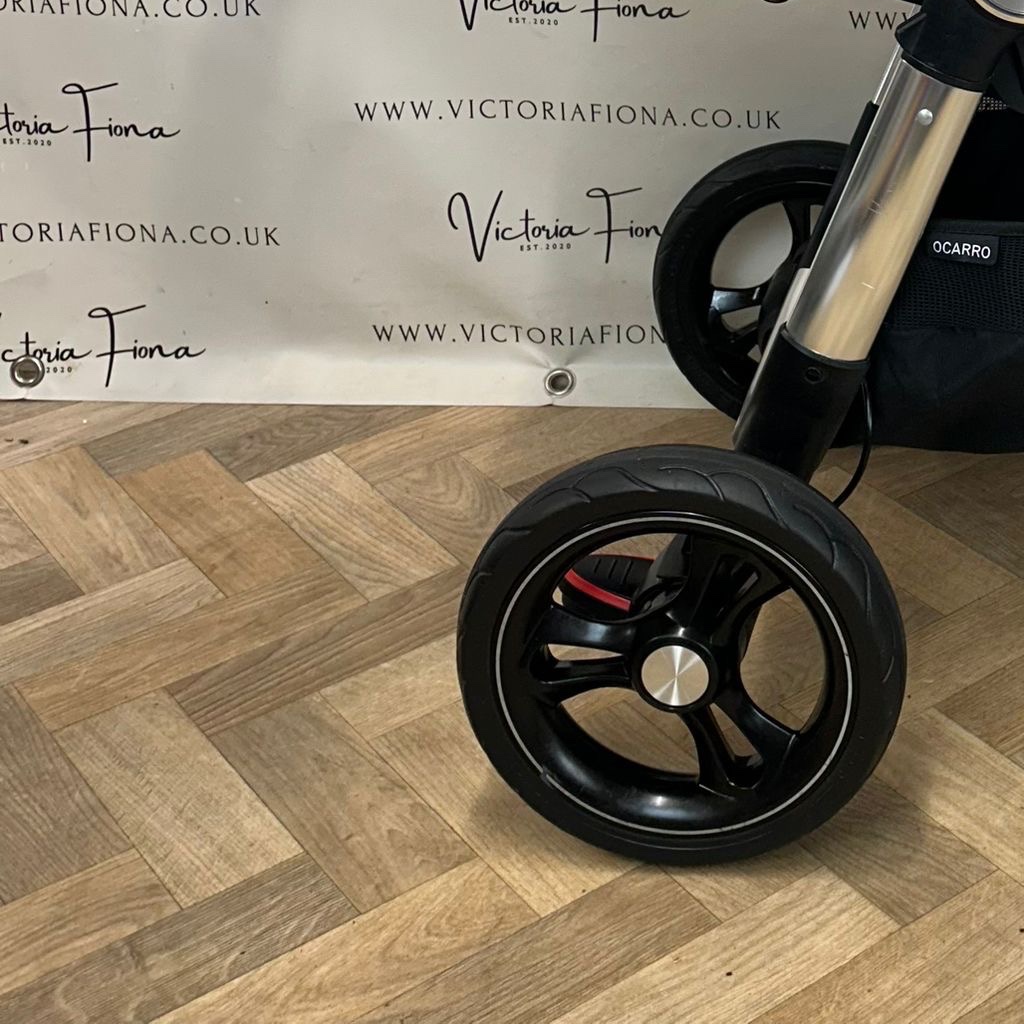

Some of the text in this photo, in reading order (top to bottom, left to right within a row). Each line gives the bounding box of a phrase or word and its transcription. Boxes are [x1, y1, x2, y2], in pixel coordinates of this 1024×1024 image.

[509, 17, 558, 26] EST.2020
[0, 83, 180, 162] toria Fiona
[354, 99, 780, 129] WWW.VICTORIAFIONA.CO.UK
[3, 138, 51, 147] EST.2020
[0, 222, 280, 246] TORIAFIONA.CO.UK
[448, 187, 661, 264] Victoria Fion
[520, 243, 571, 251] EST.2020
[933, 240, 991, 259] OCARRO
[0, 305, 206, 387] ctoria Fiona
[372, 324, 666, 347] WWW.VICTORIAFION
[45, 366, 72, 375] 2020
